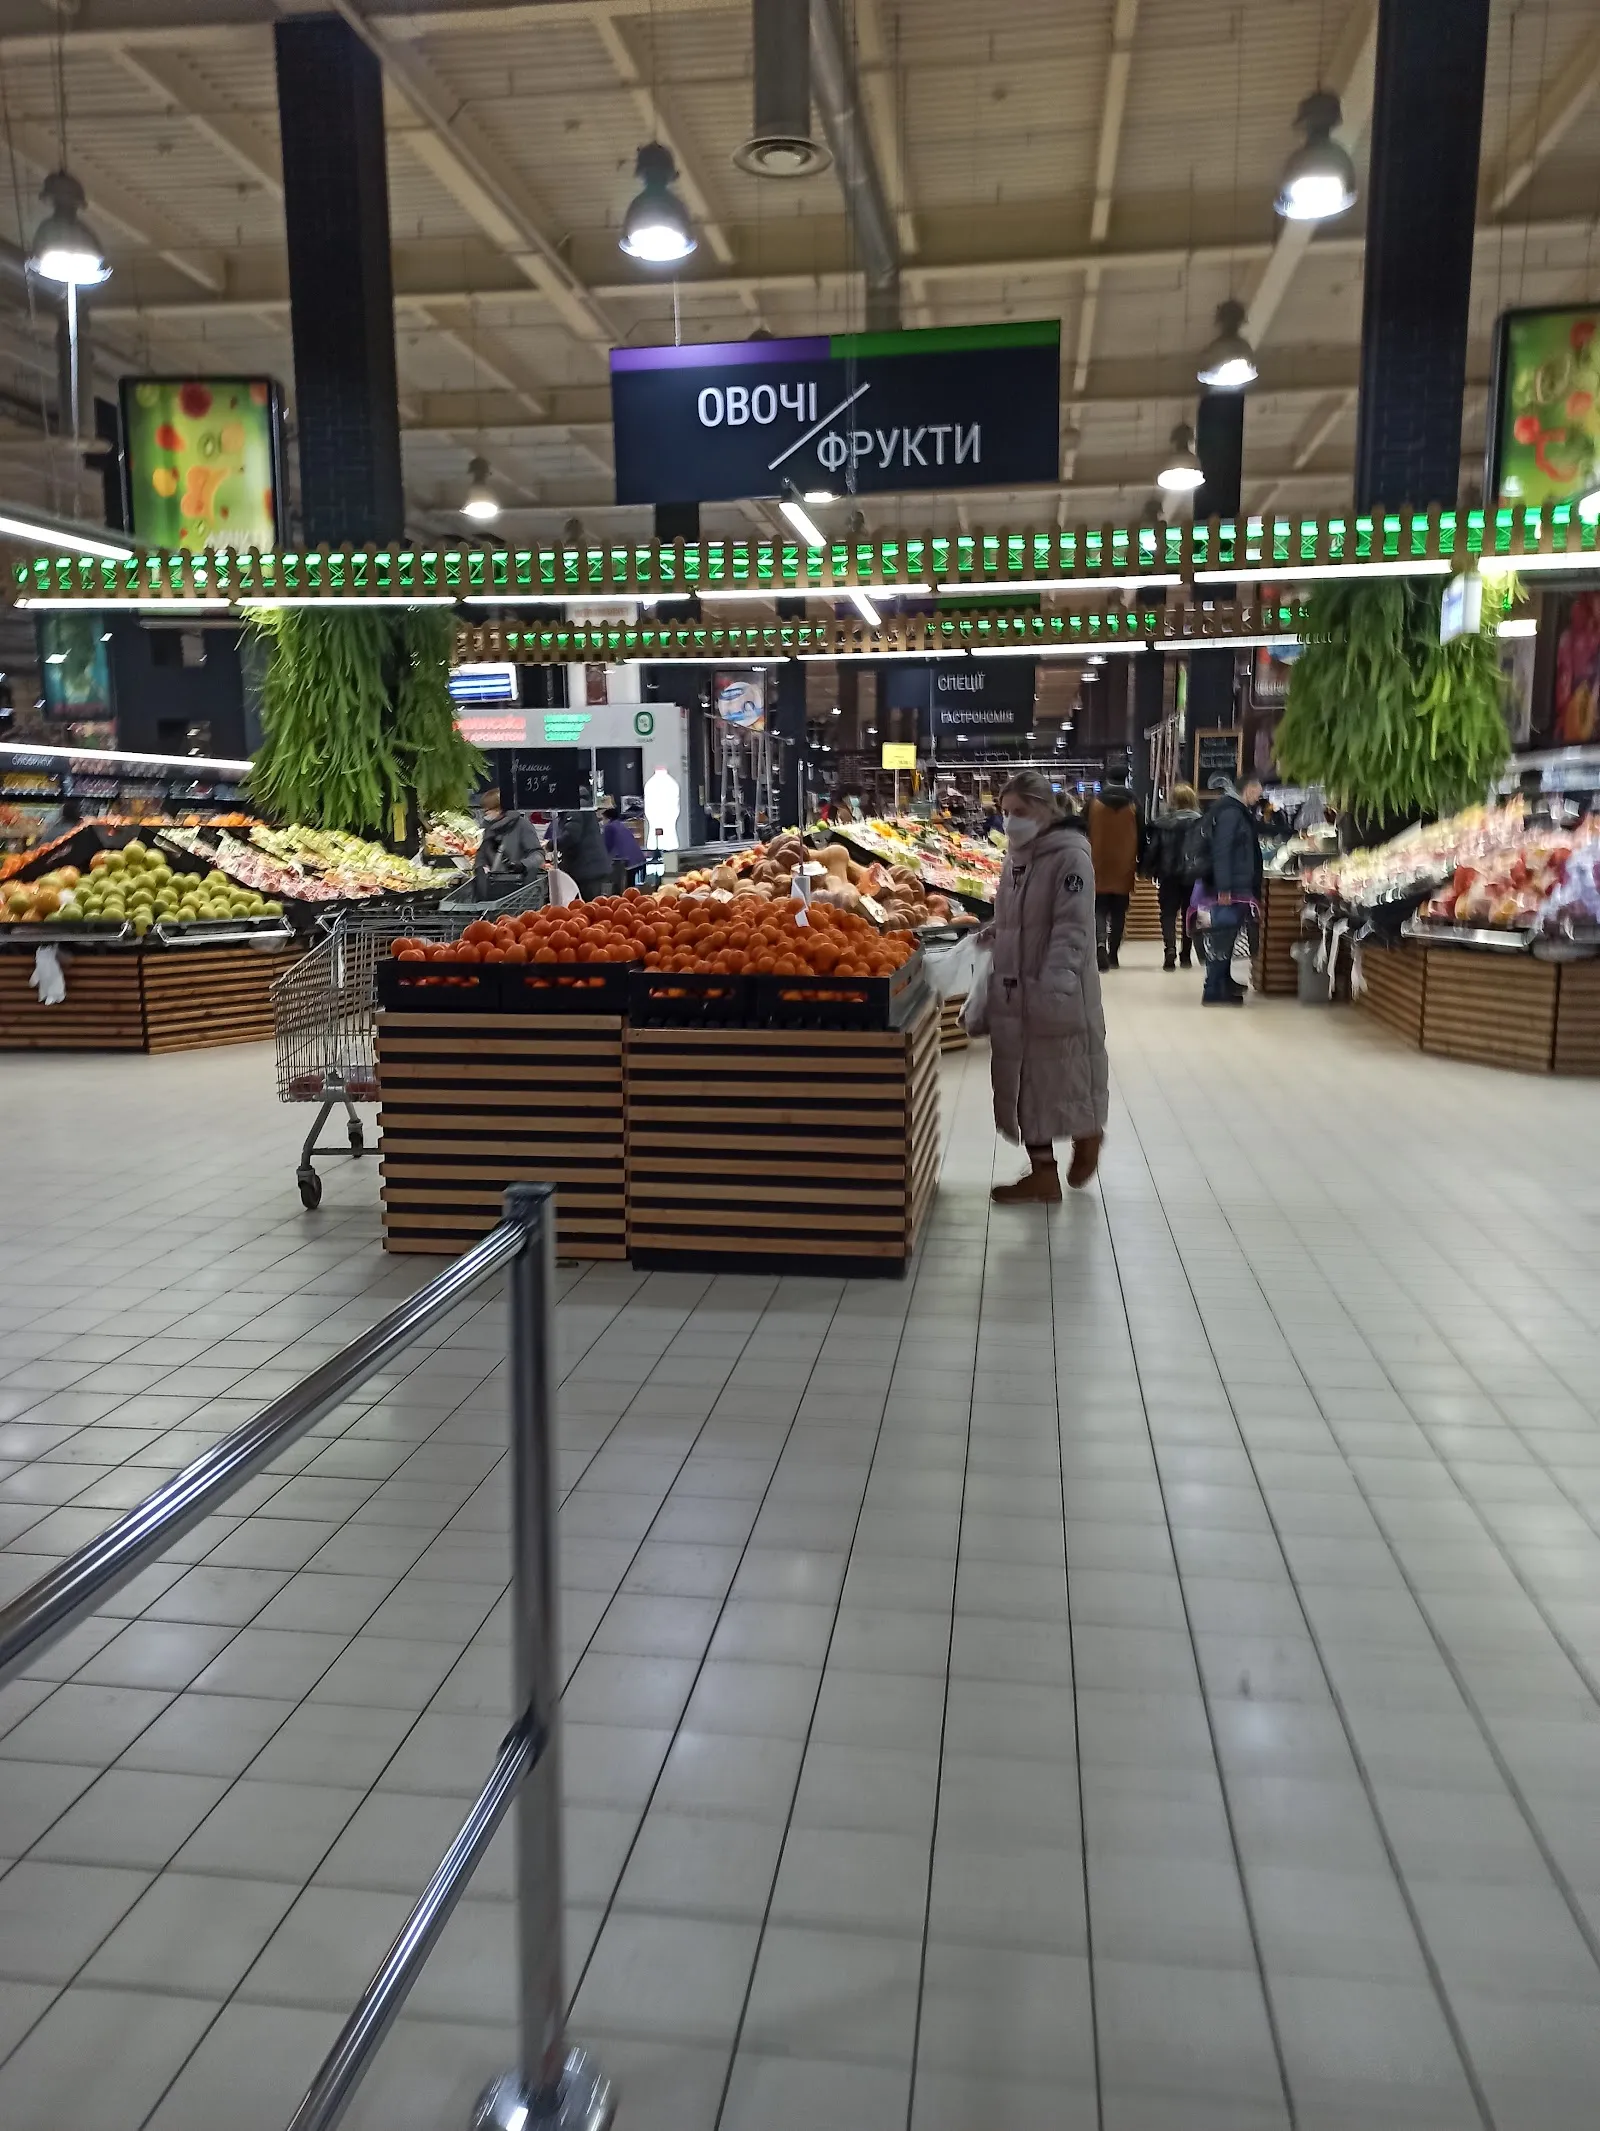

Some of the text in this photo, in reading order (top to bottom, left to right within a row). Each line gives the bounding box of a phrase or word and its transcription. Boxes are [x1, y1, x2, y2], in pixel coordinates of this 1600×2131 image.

[697, 382, 817, 427] ОВОЧІ
[817, 424, 981, 472] ФРУКТИ
[937, 672, 985, 692] СПЕЦІЇ
[940, 710, 1014, 724] ГАСТРОНОМІЯ
